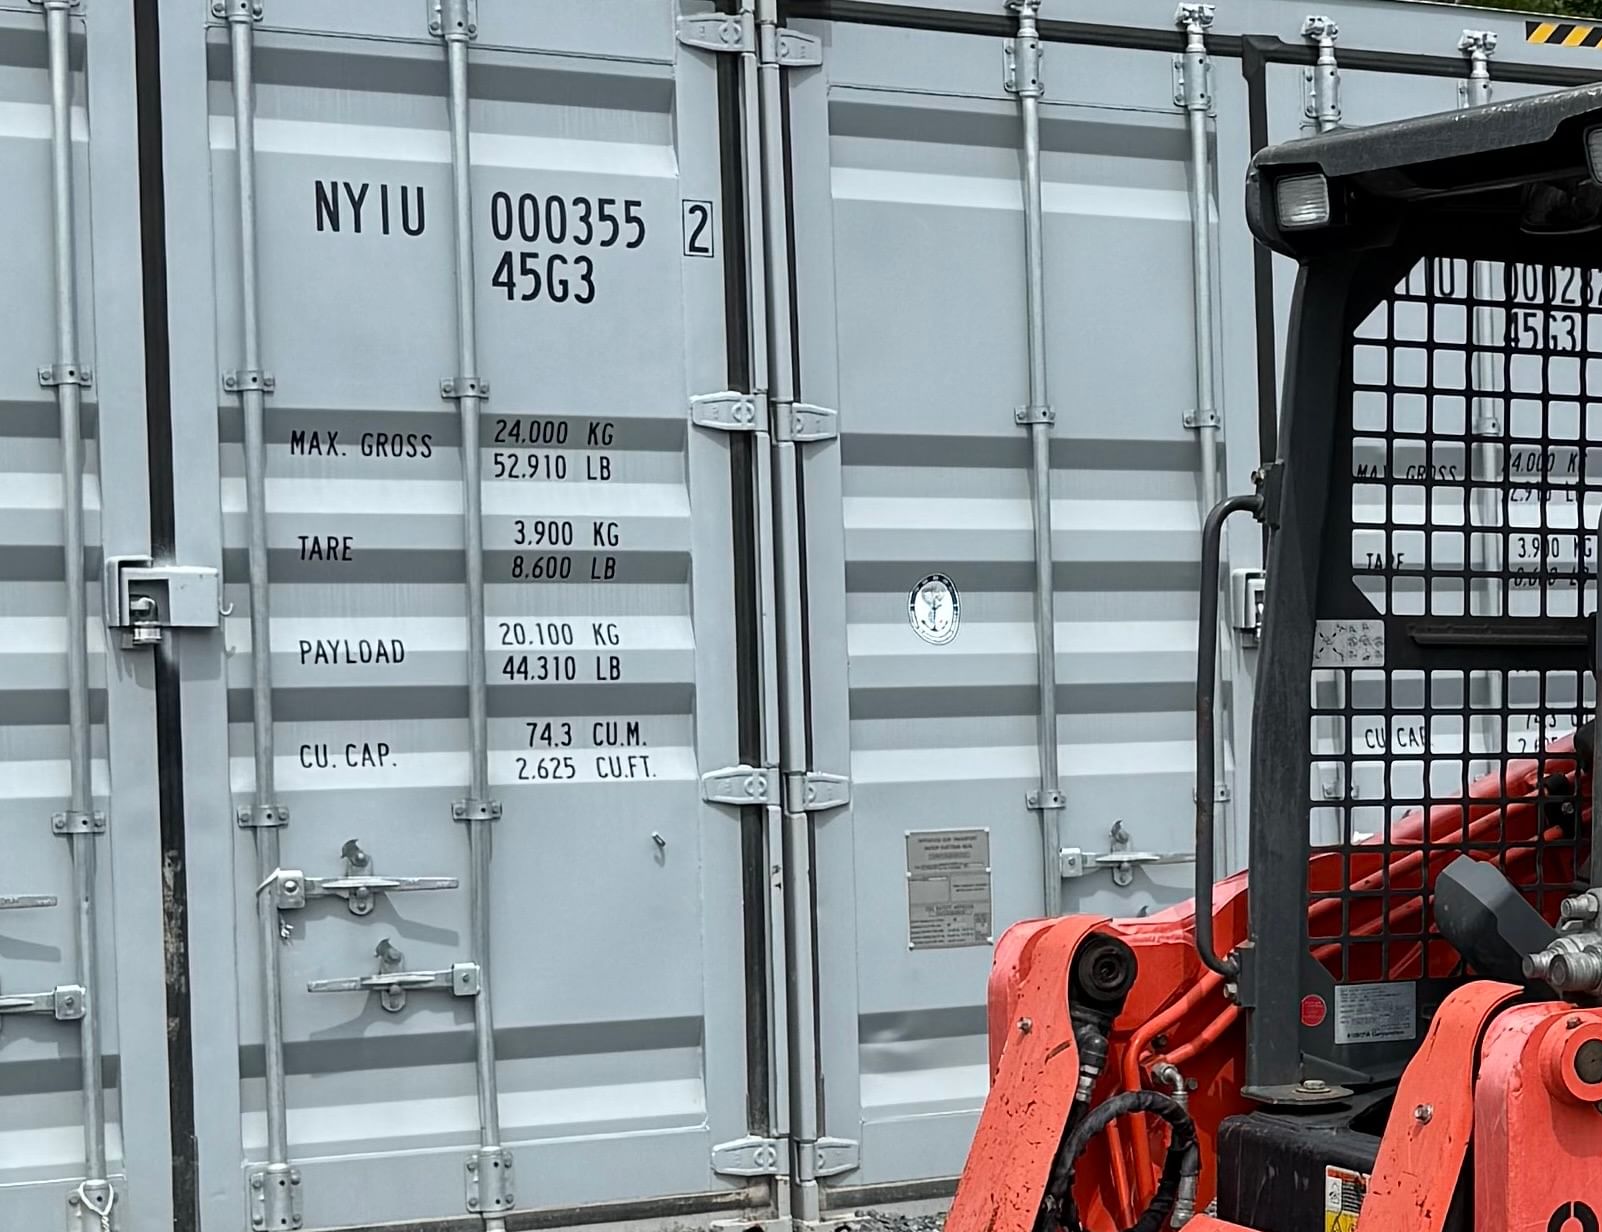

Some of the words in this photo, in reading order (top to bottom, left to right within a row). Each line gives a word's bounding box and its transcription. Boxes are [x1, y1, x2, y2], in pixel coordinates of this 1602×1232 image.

[314, 180, 426, 237] NYIU
[490, 191, 646, 249] 000355
[688, 203, 710, 254] 2
[491, 250, 596, 305] 45G3
[290, 429, 348, 458] MAX.
[361, 431, 433, 459] GROSS
[586, 421, 614, 447] KG
[586, 455, 611, 482] LB
[593, 521, 620, 548] KG
[297, 535, 354, 562] TARE
[590, 556, 617, 581] LB
[592, 622, 620, 647] KG
[298, 638, 406, 665] PAYLOAD
[596, 655, 621, 682] LB
[525, 721, 573, 748] 74.3
